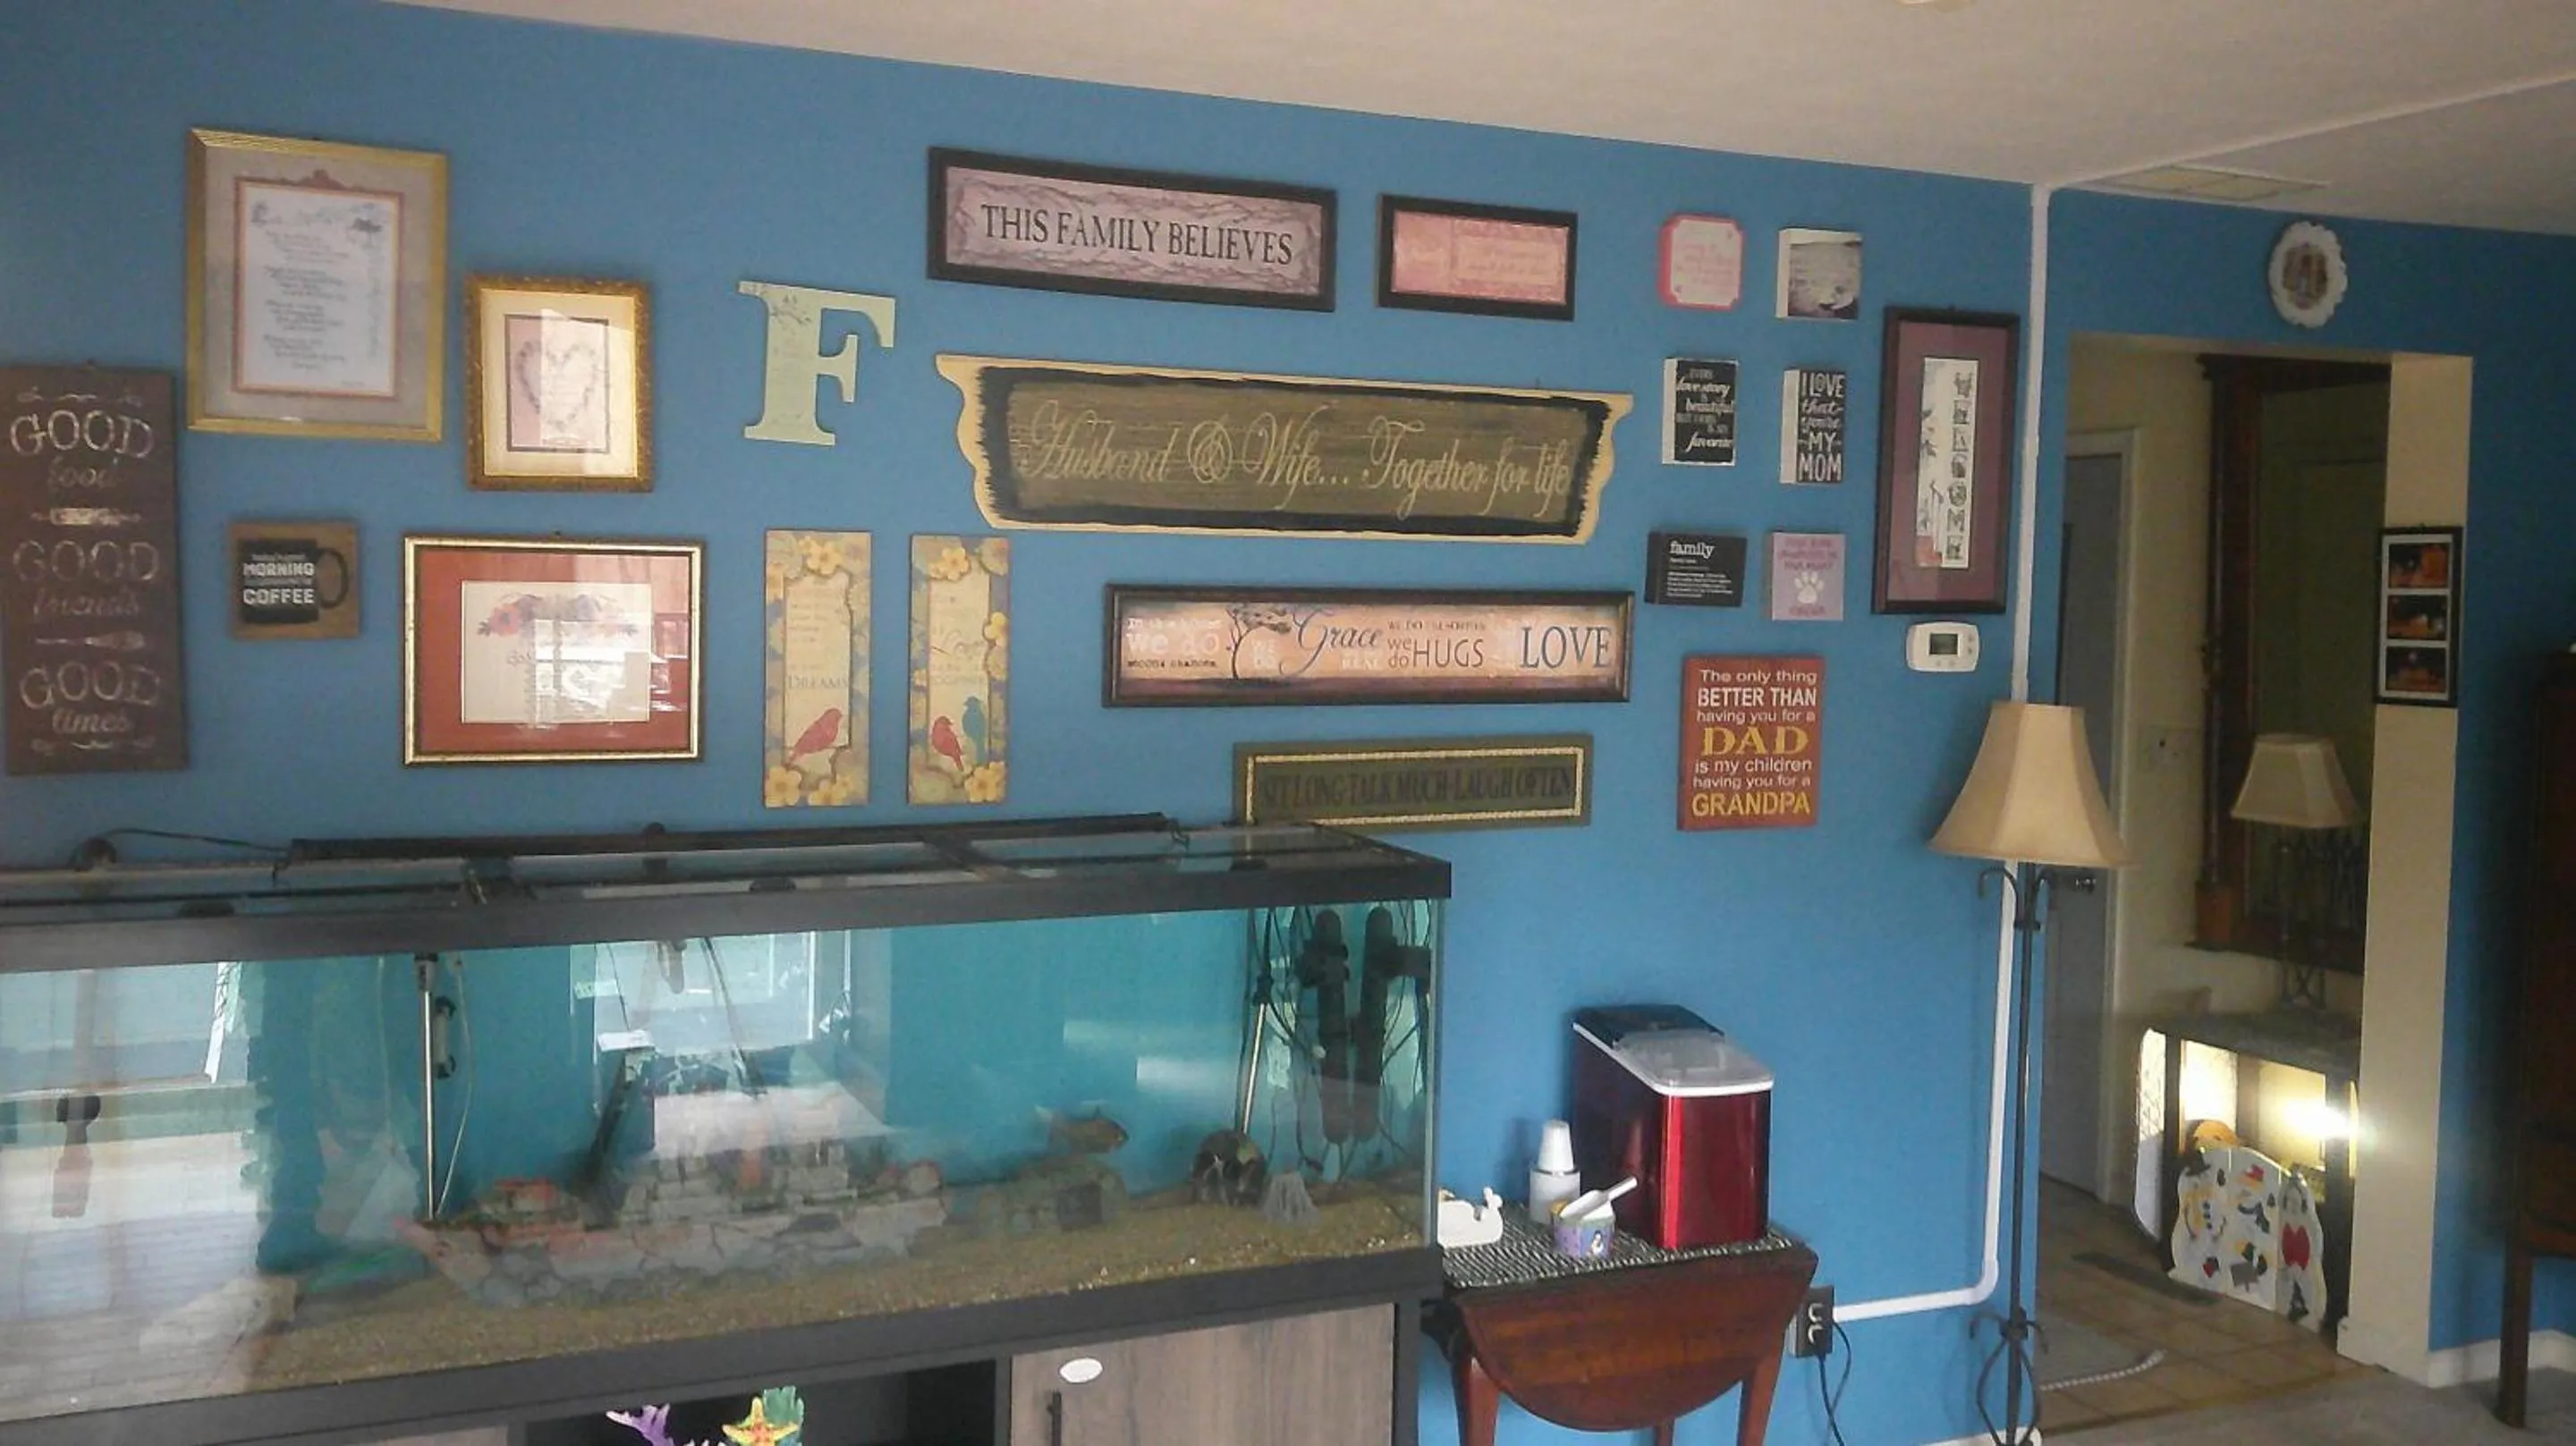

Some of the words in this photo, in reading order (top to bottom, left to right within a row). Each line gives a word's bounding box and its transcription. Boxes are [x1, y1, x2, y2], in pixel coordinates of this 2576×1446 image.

[981, 204, 1048, 243] THIS
[1056, 211, 1161, 254] FAMILY
[1168, 221, 1293, 266] BELIEVES
[738, 280, 896, 445] F
[1801, 372, 1807, 396] I
[1809, 372, 1844, 397] LOVE
[11, 409, 155, 460] GOOD
[1809, 432, 1836, 452] MY
[1021, 400, 1180, 483] Husband
[1363, 416, 1488, 521] Together
[1477, 437, 1530, 516] for
[1533, 438, 1570, 518] life
[1799, 452, 1843, 481] MOM
[13, 539, 159, 583] GOOD
[1669, 540, 1716, 559] family
[242, 562, 316, 577] MORNING
[242, 588, 316, 605] COFFEE
[1279, 608, 1383, 676] Grace
[1387, 638, 1412, 652] we
[1412, 638, 1485, 669] HUGS
[1521, 626, 1610, 669] LOVE
[1388, 651, 1411, 669] do
[20, 658, 162, 710] GOOD
[1701, 669, 1732, 683] The
[1736, 670, 1771, 686] only
[1775, 669, 1818, 685] thing
[1697, 687, 1765, 707] BETTER
[1769, 687, 1818, 707] THAN
[1696, 709, 1745, 725] having
[1750, 712, 1776, 725] you
[1782, 708, 1802, 722] for
[1806, 712, 1816, 722] a
[1700, 725, 1809, 757] DAD
[1695, 758, 1709, 774] is
[1714, 760, 1740, 775] my
[1745, 757, 1812, 773] children
[1293, 773, 1343, 805] LONG
[1397, 769, 1448, 802] MUCH
[1454, 767, 1513, 799] LAUGH
[1692, 775, 1741, 791] having
[1745, 776, 1773, 791] you
[1777, 774, 1798, 787] for
[1801, 776, 1811, 787] a
[1691, 791, 1811, 816] GRANDPA
